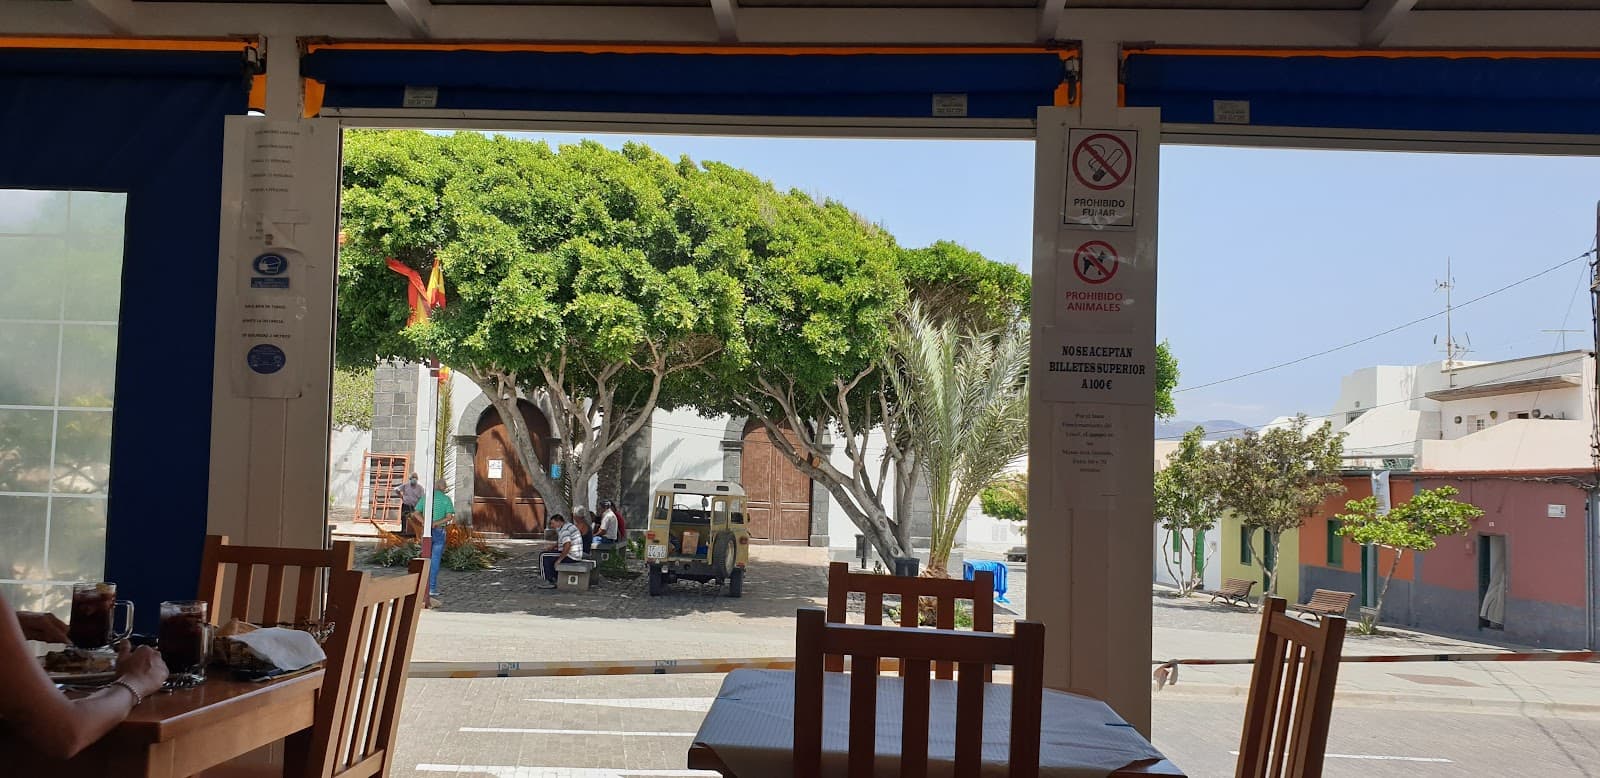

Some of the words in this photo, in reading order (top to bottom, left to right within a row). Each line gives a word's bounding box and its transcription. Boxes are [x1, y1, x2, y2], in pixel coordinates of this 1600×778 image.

[1073, 198, 1126, 208] PROHIBIDO
[1065, 291, 1123, 302] PROHIBIDO
[1066, 302, 1121, 312] ANIMALES
[1062, 345, 1075, 357] NO
[1076, 346, 1088, 357] SE
[1088, 346, 1133, 358] ACEPTAN
[1049, 361, 1095, 373] BILLETES
[1097, 362, 1146, 375] SUPERIOR
[1081, 378, 1088, 389] A
